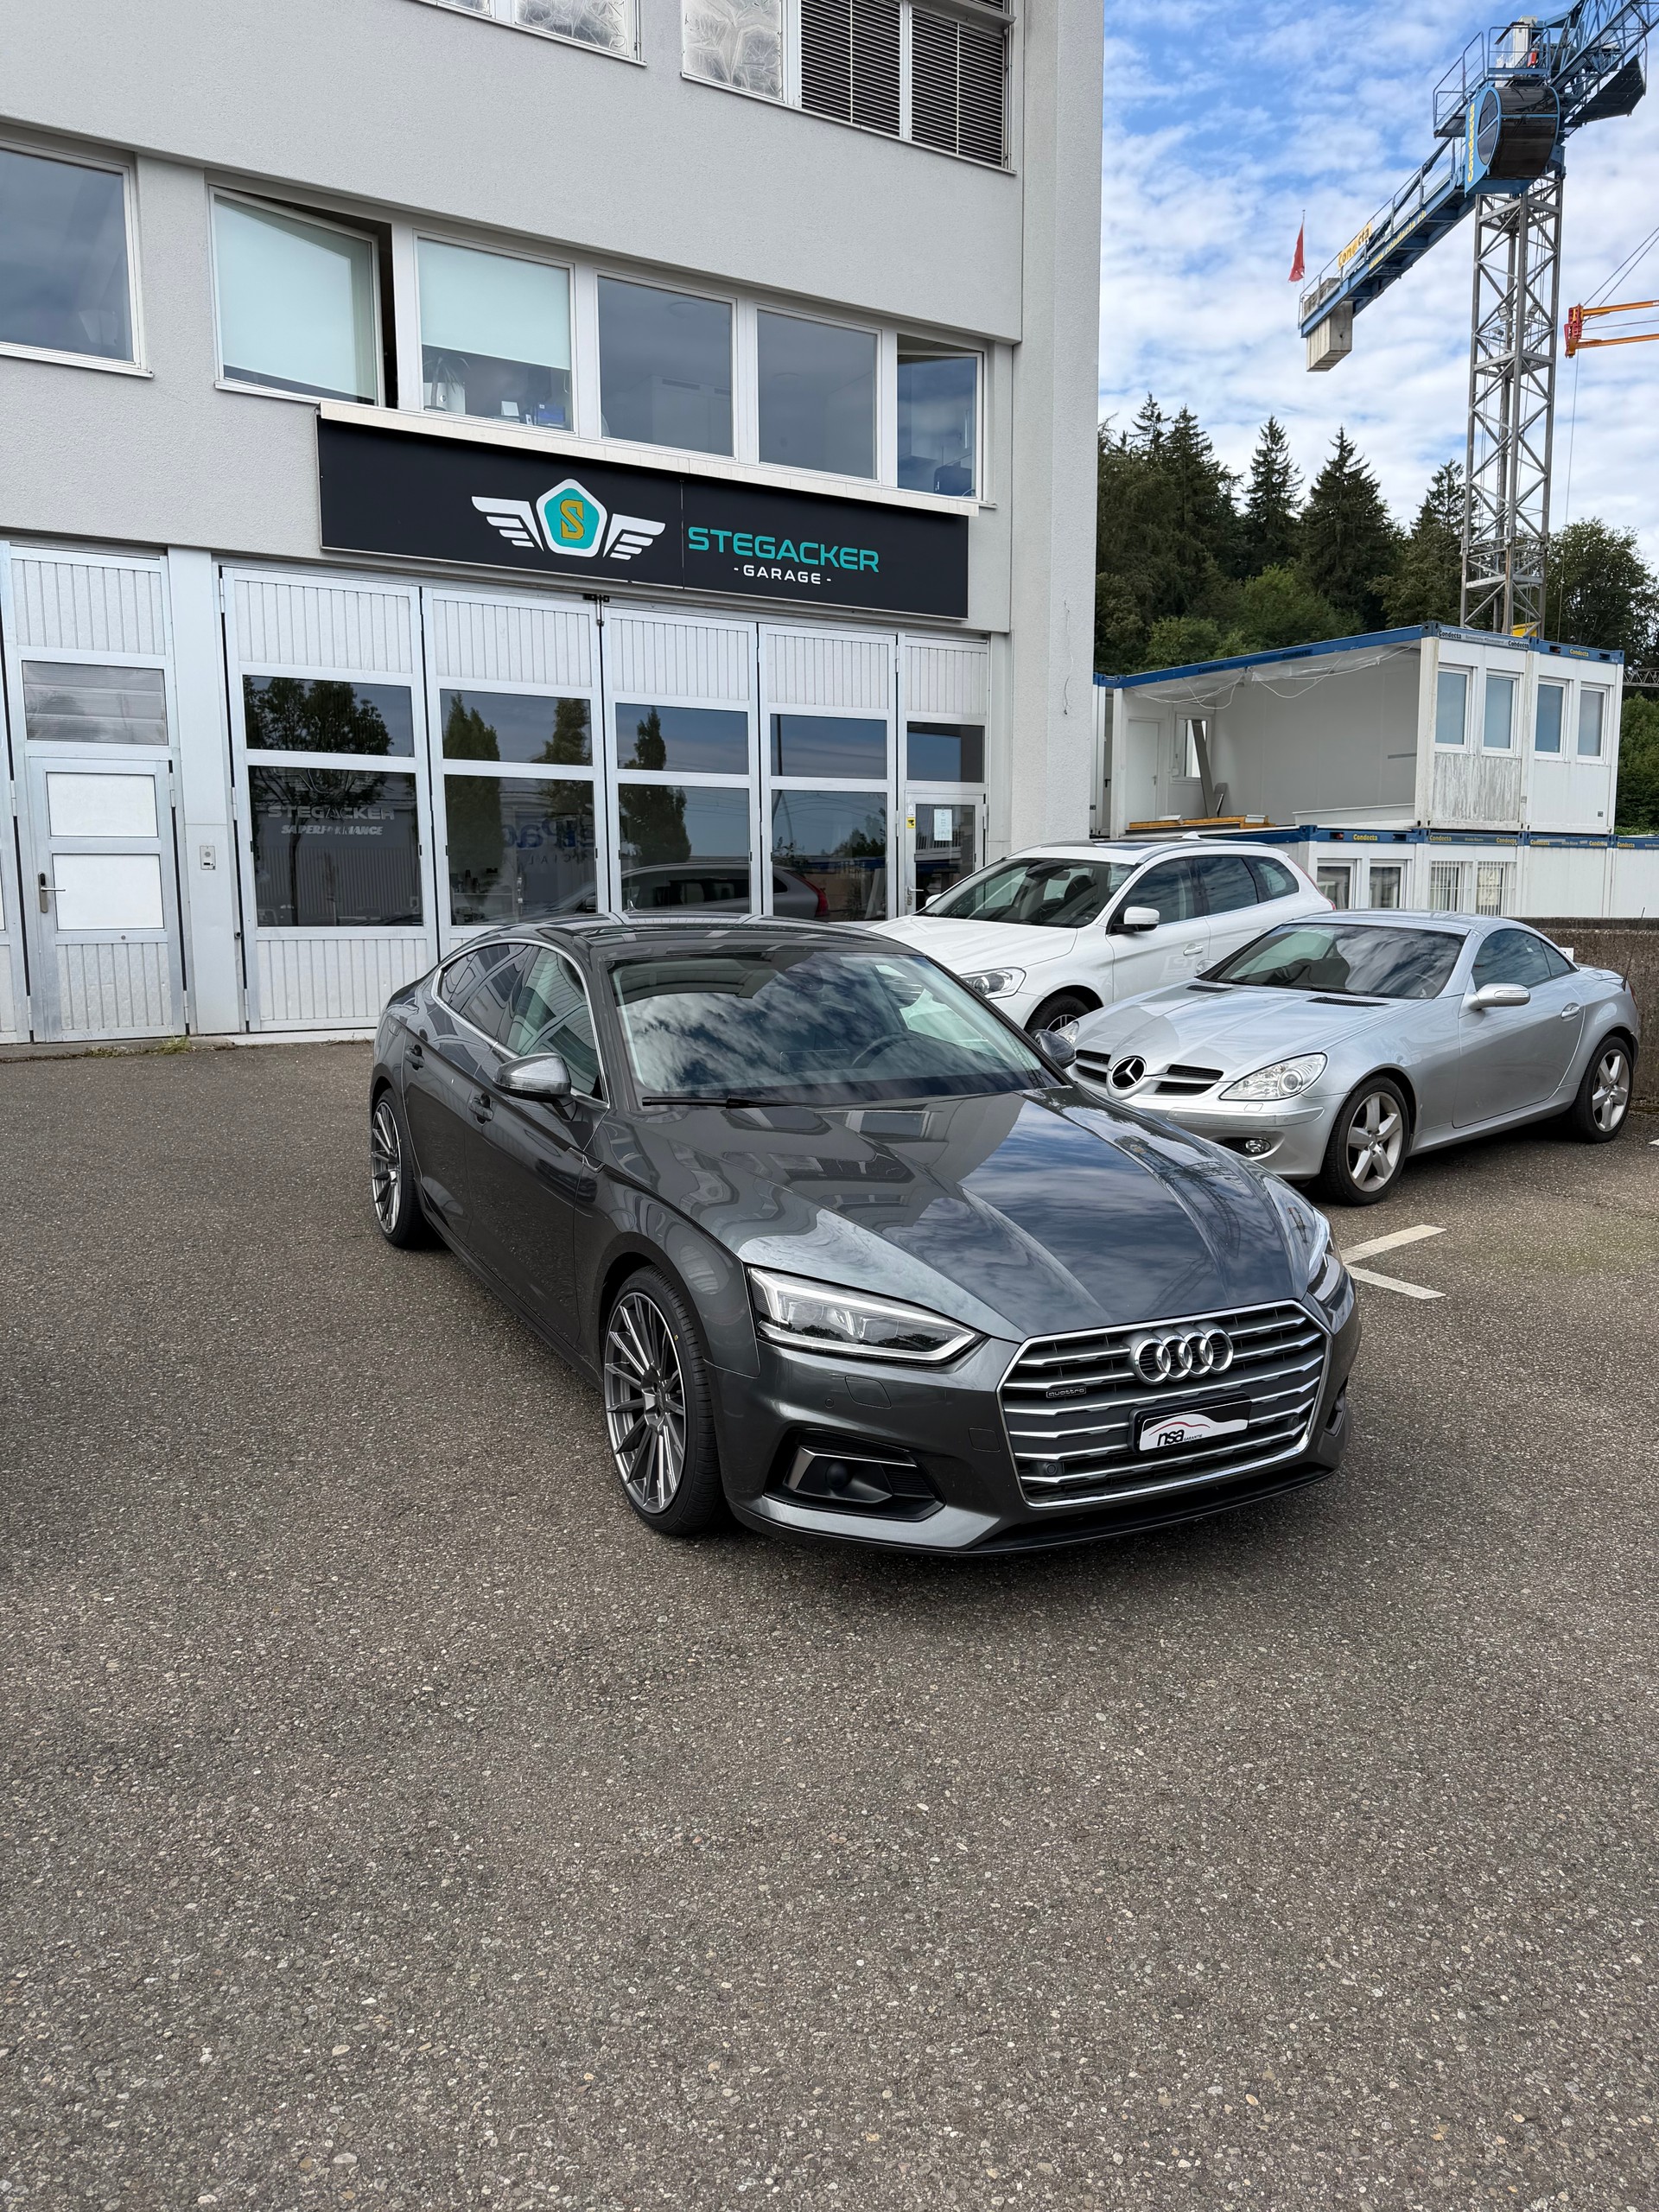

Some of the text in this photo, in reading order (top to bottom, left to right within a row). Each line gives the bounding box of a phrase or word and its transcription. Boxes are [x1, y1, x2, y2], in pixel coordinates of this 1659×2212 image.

[688, 526, 880, 573] STEGACKER
[1438, 631, 1462, 639] Condecta
[268, 805, 395, 820] STEGACKER
[1048, 1389, 1085, 1397] quattro
[1157, 1429, 1185, 1447] nsa
